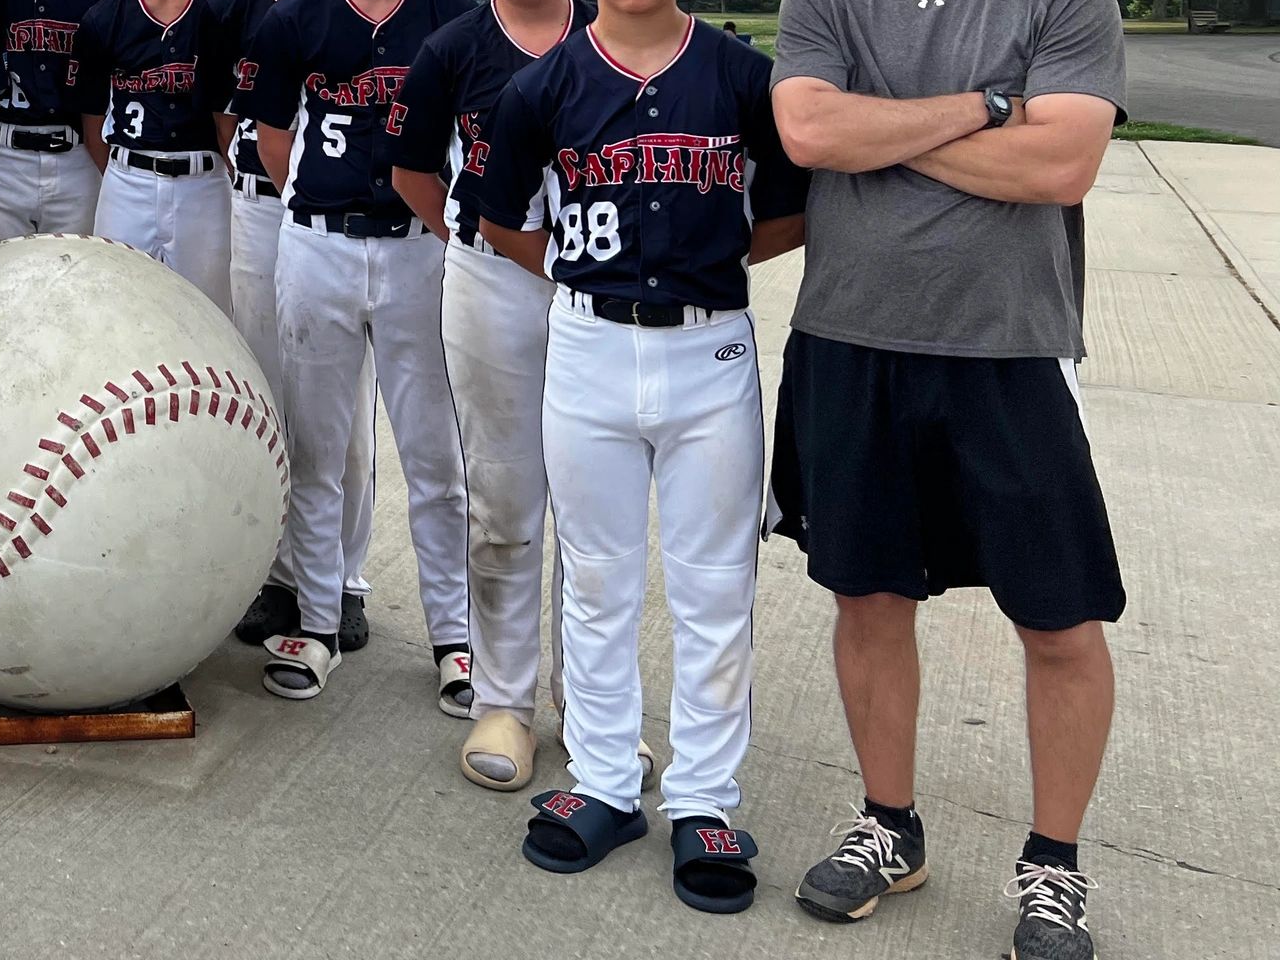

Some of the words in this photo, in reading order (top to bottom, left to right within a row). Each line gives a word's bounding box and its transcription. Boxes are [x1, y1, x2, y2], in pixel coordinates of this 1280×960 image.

[122, 101, 145, 139] 3
[320, 113, 353, 158] 5
[558, 134, 745, 194] CAPTAINS
[558, 201, 621, 262] 88
[542, 792, 587, 819] FC
[696, 828, 741, 854] FC
